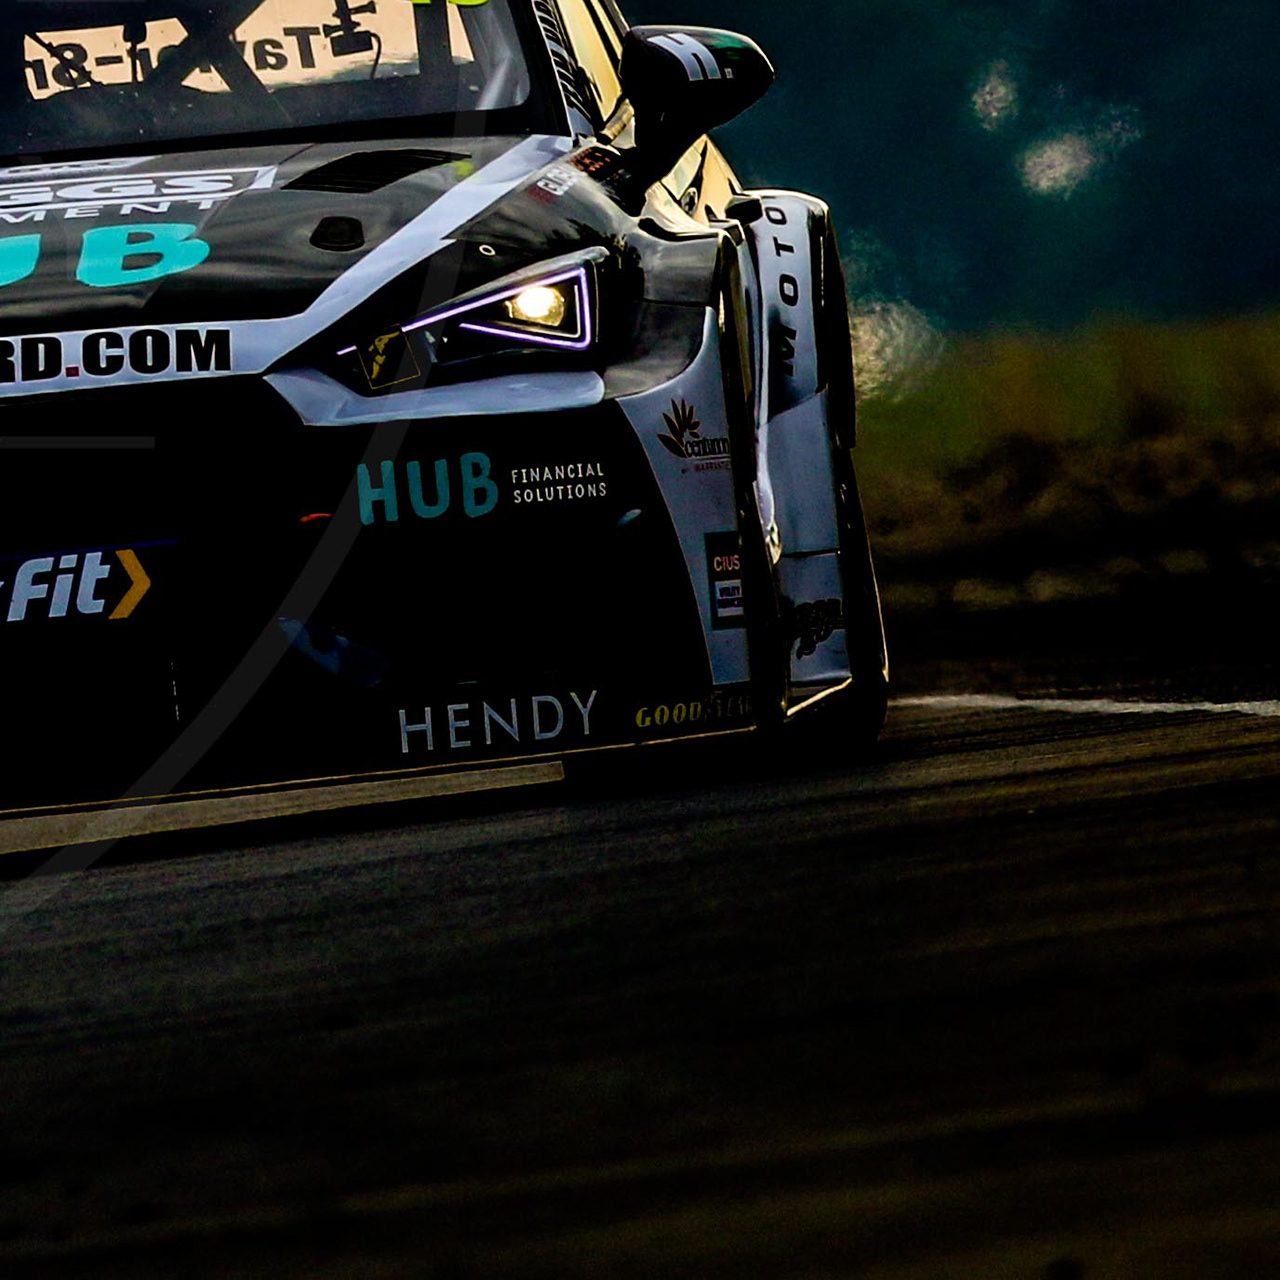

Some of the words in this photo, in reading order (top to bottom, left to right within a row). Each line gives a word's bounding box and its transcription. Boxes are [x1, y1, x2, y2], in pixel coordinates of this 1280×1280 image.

[356, 452, 499, 525] HUB
[511, 462, 604, 484] FINANCIAL
[513, 482, 607, 504] SOLUTIONS
[397, 689, 598, 754] HENDY
